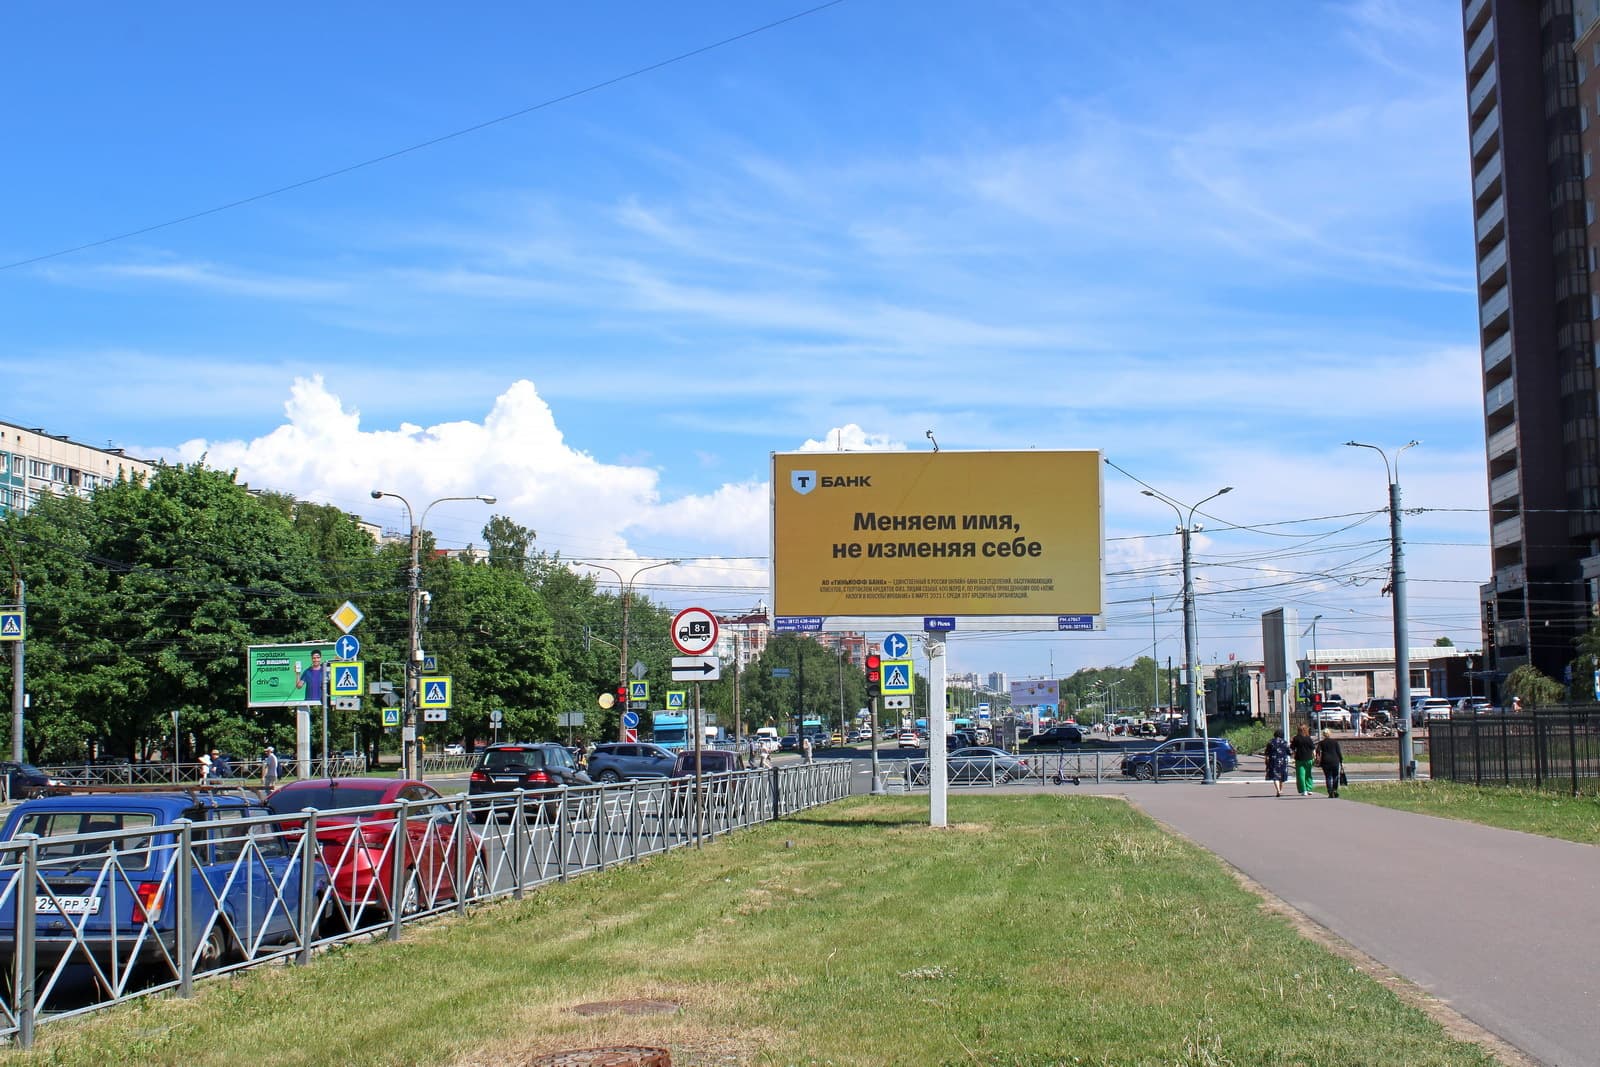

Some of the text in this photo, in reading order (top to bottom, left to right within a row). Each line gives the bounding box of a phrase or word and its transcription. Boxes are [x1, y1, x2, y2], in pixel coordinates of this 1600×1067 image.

[821, 476, 872, 488] БАНК
[853, 512, 1020, 533] Меняем имя,
[832, 536, 1042, 558] не изменяя себе
